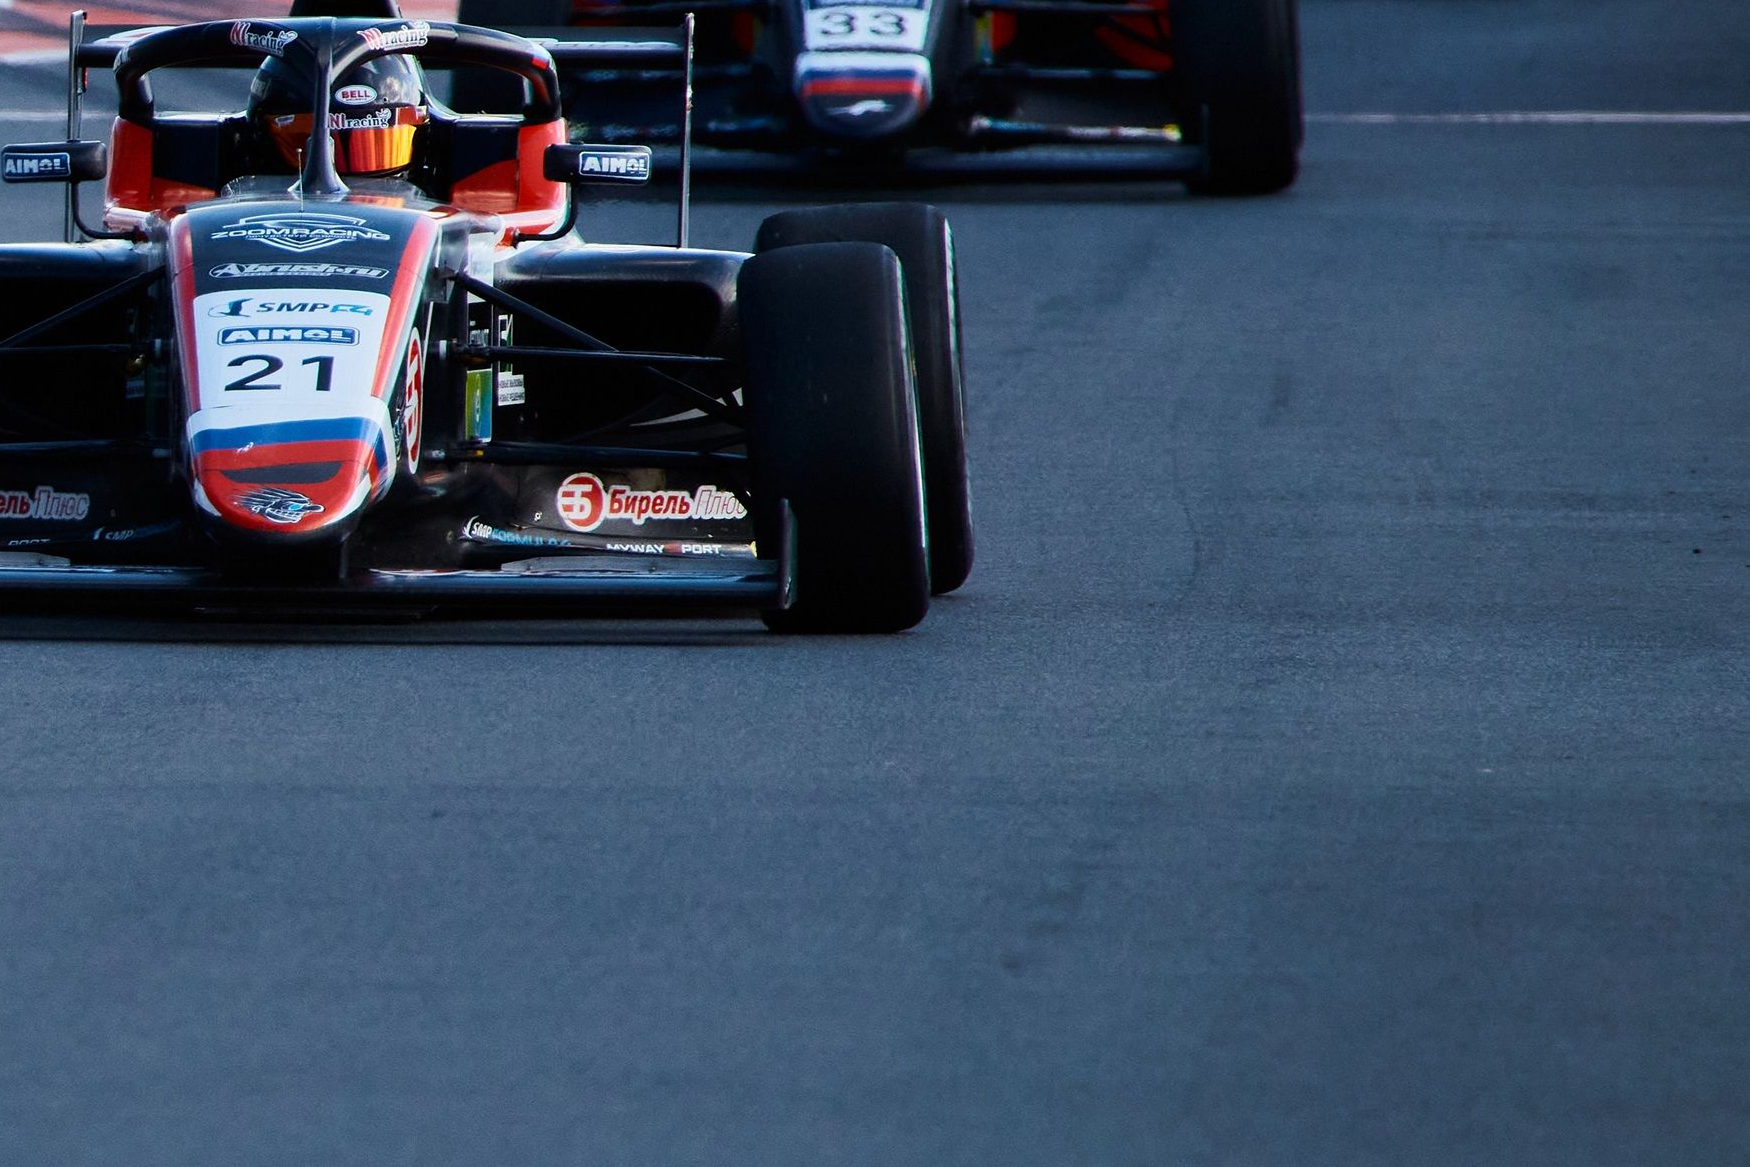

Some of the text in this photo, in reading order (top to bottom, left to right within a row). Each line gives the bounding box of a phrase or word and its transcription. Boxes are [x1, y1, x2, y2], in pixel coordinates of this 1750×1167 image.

[821, 11, 906, 37] 33
[341, 89, 371, 99] BELL
[5, 158, 66, 173] AIMOL
[583, 156, 647, 174] AIMOL
[224, 328, 352, 343] AIMOL
[224, 354, 334, 391] 21
[609, 488, 690, 520] Бирель
